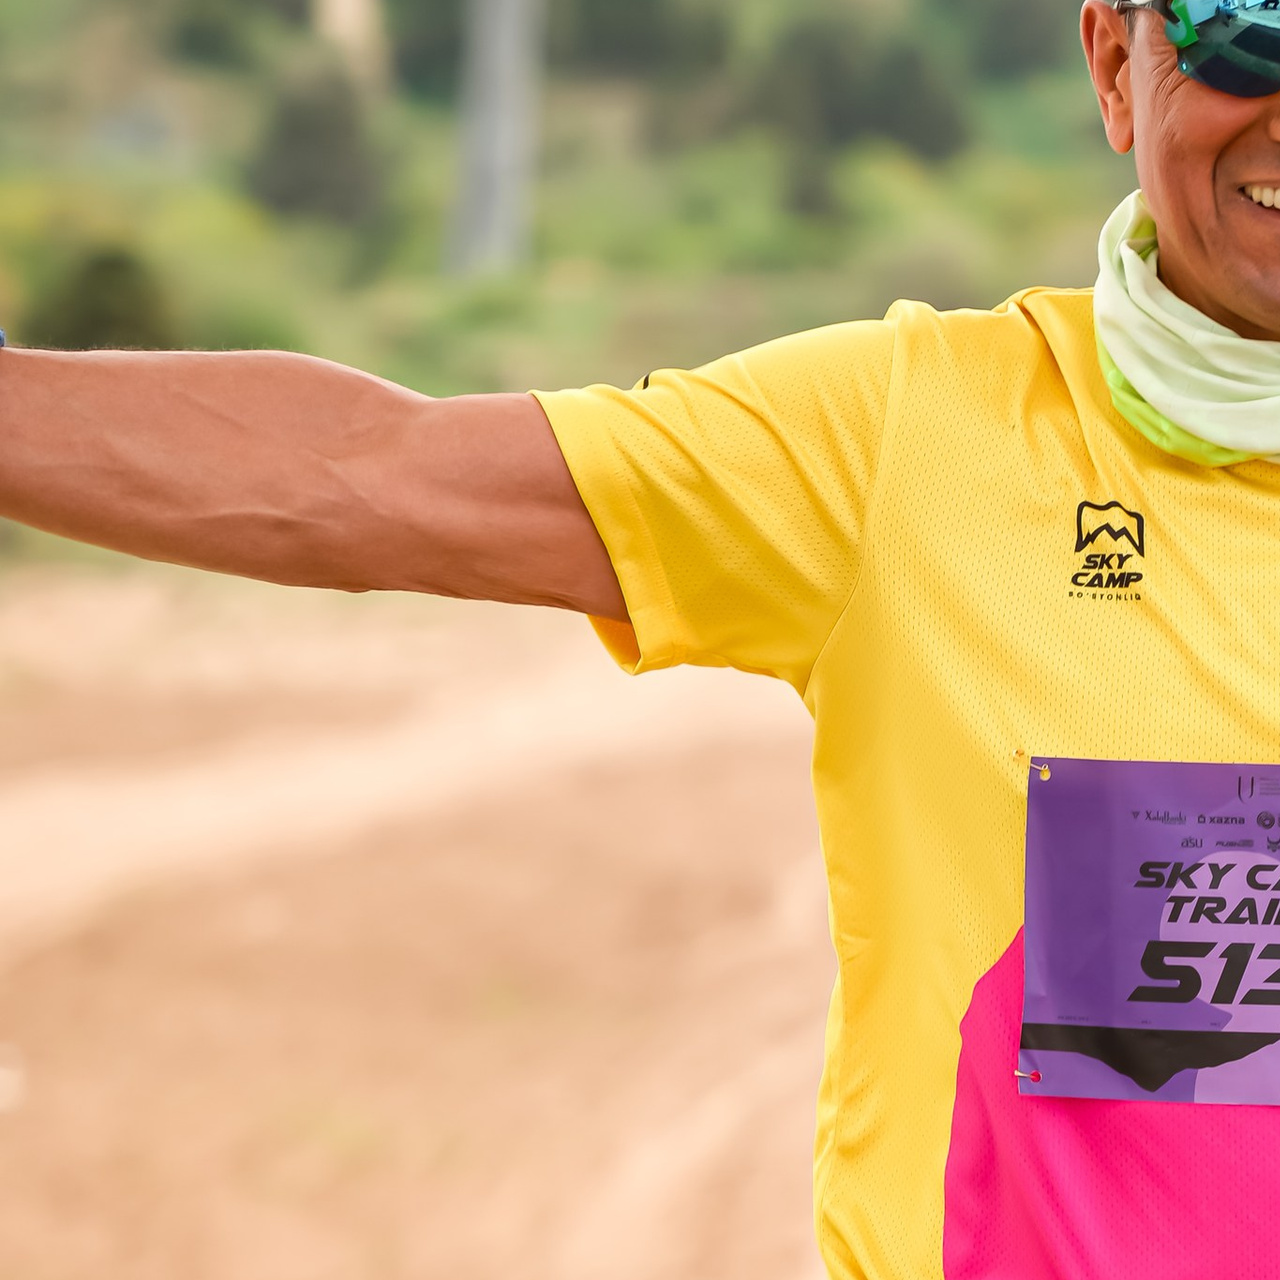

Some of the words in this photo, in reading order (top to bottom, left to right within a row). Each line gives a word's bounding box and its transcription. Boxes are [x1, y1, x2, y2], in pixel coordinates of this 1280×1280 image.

[1081, 553, 1134, 570] SKY
[1071, 572, 1143, 589] CAMP
[1208, 816, 1246, 825] xazna
[1134, 861, 1237, 889] SKY
